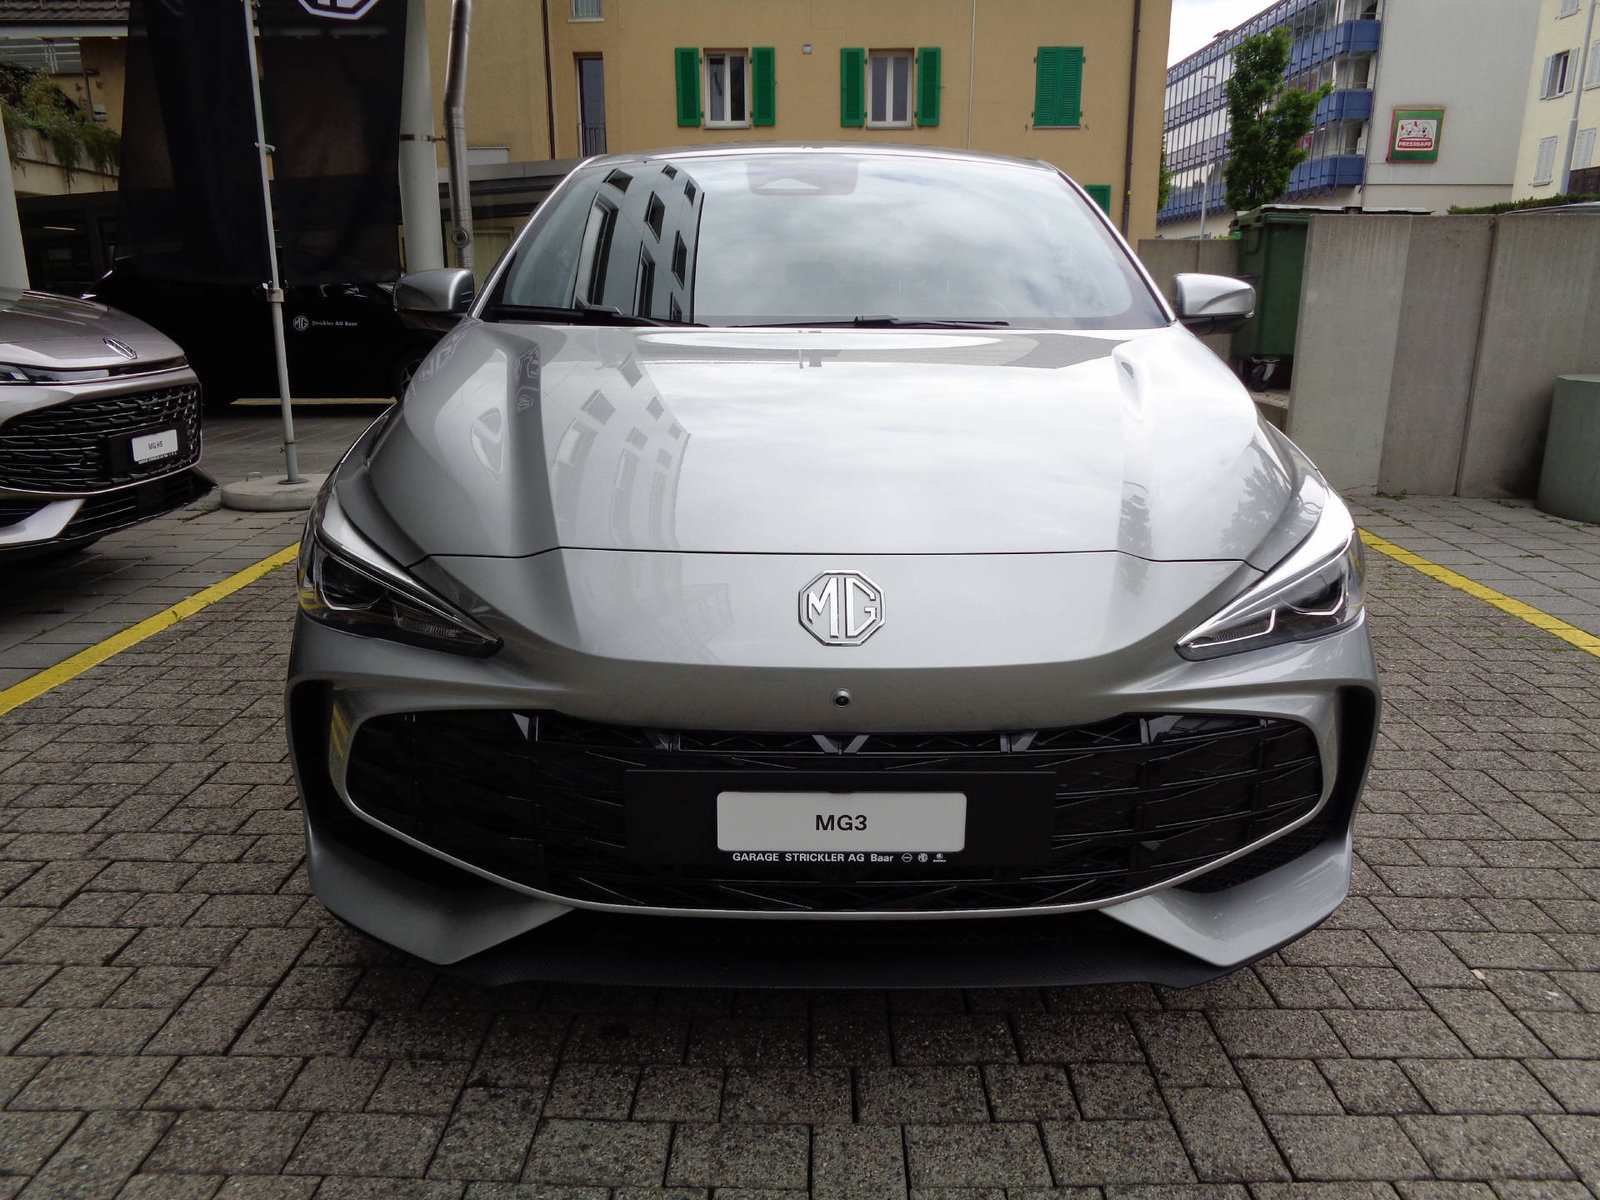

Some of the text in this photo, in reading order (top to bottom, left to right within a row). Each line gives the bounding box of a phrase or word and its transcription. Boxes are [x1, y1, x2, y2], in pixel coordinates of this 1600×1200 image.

[293, 316, 308, 331] MG
[805, 576, 879, 640] MG
[815, 814, 868, 831] MG3
[732, 852, 894, 862] GARAGE STRICKLER AG Baar
